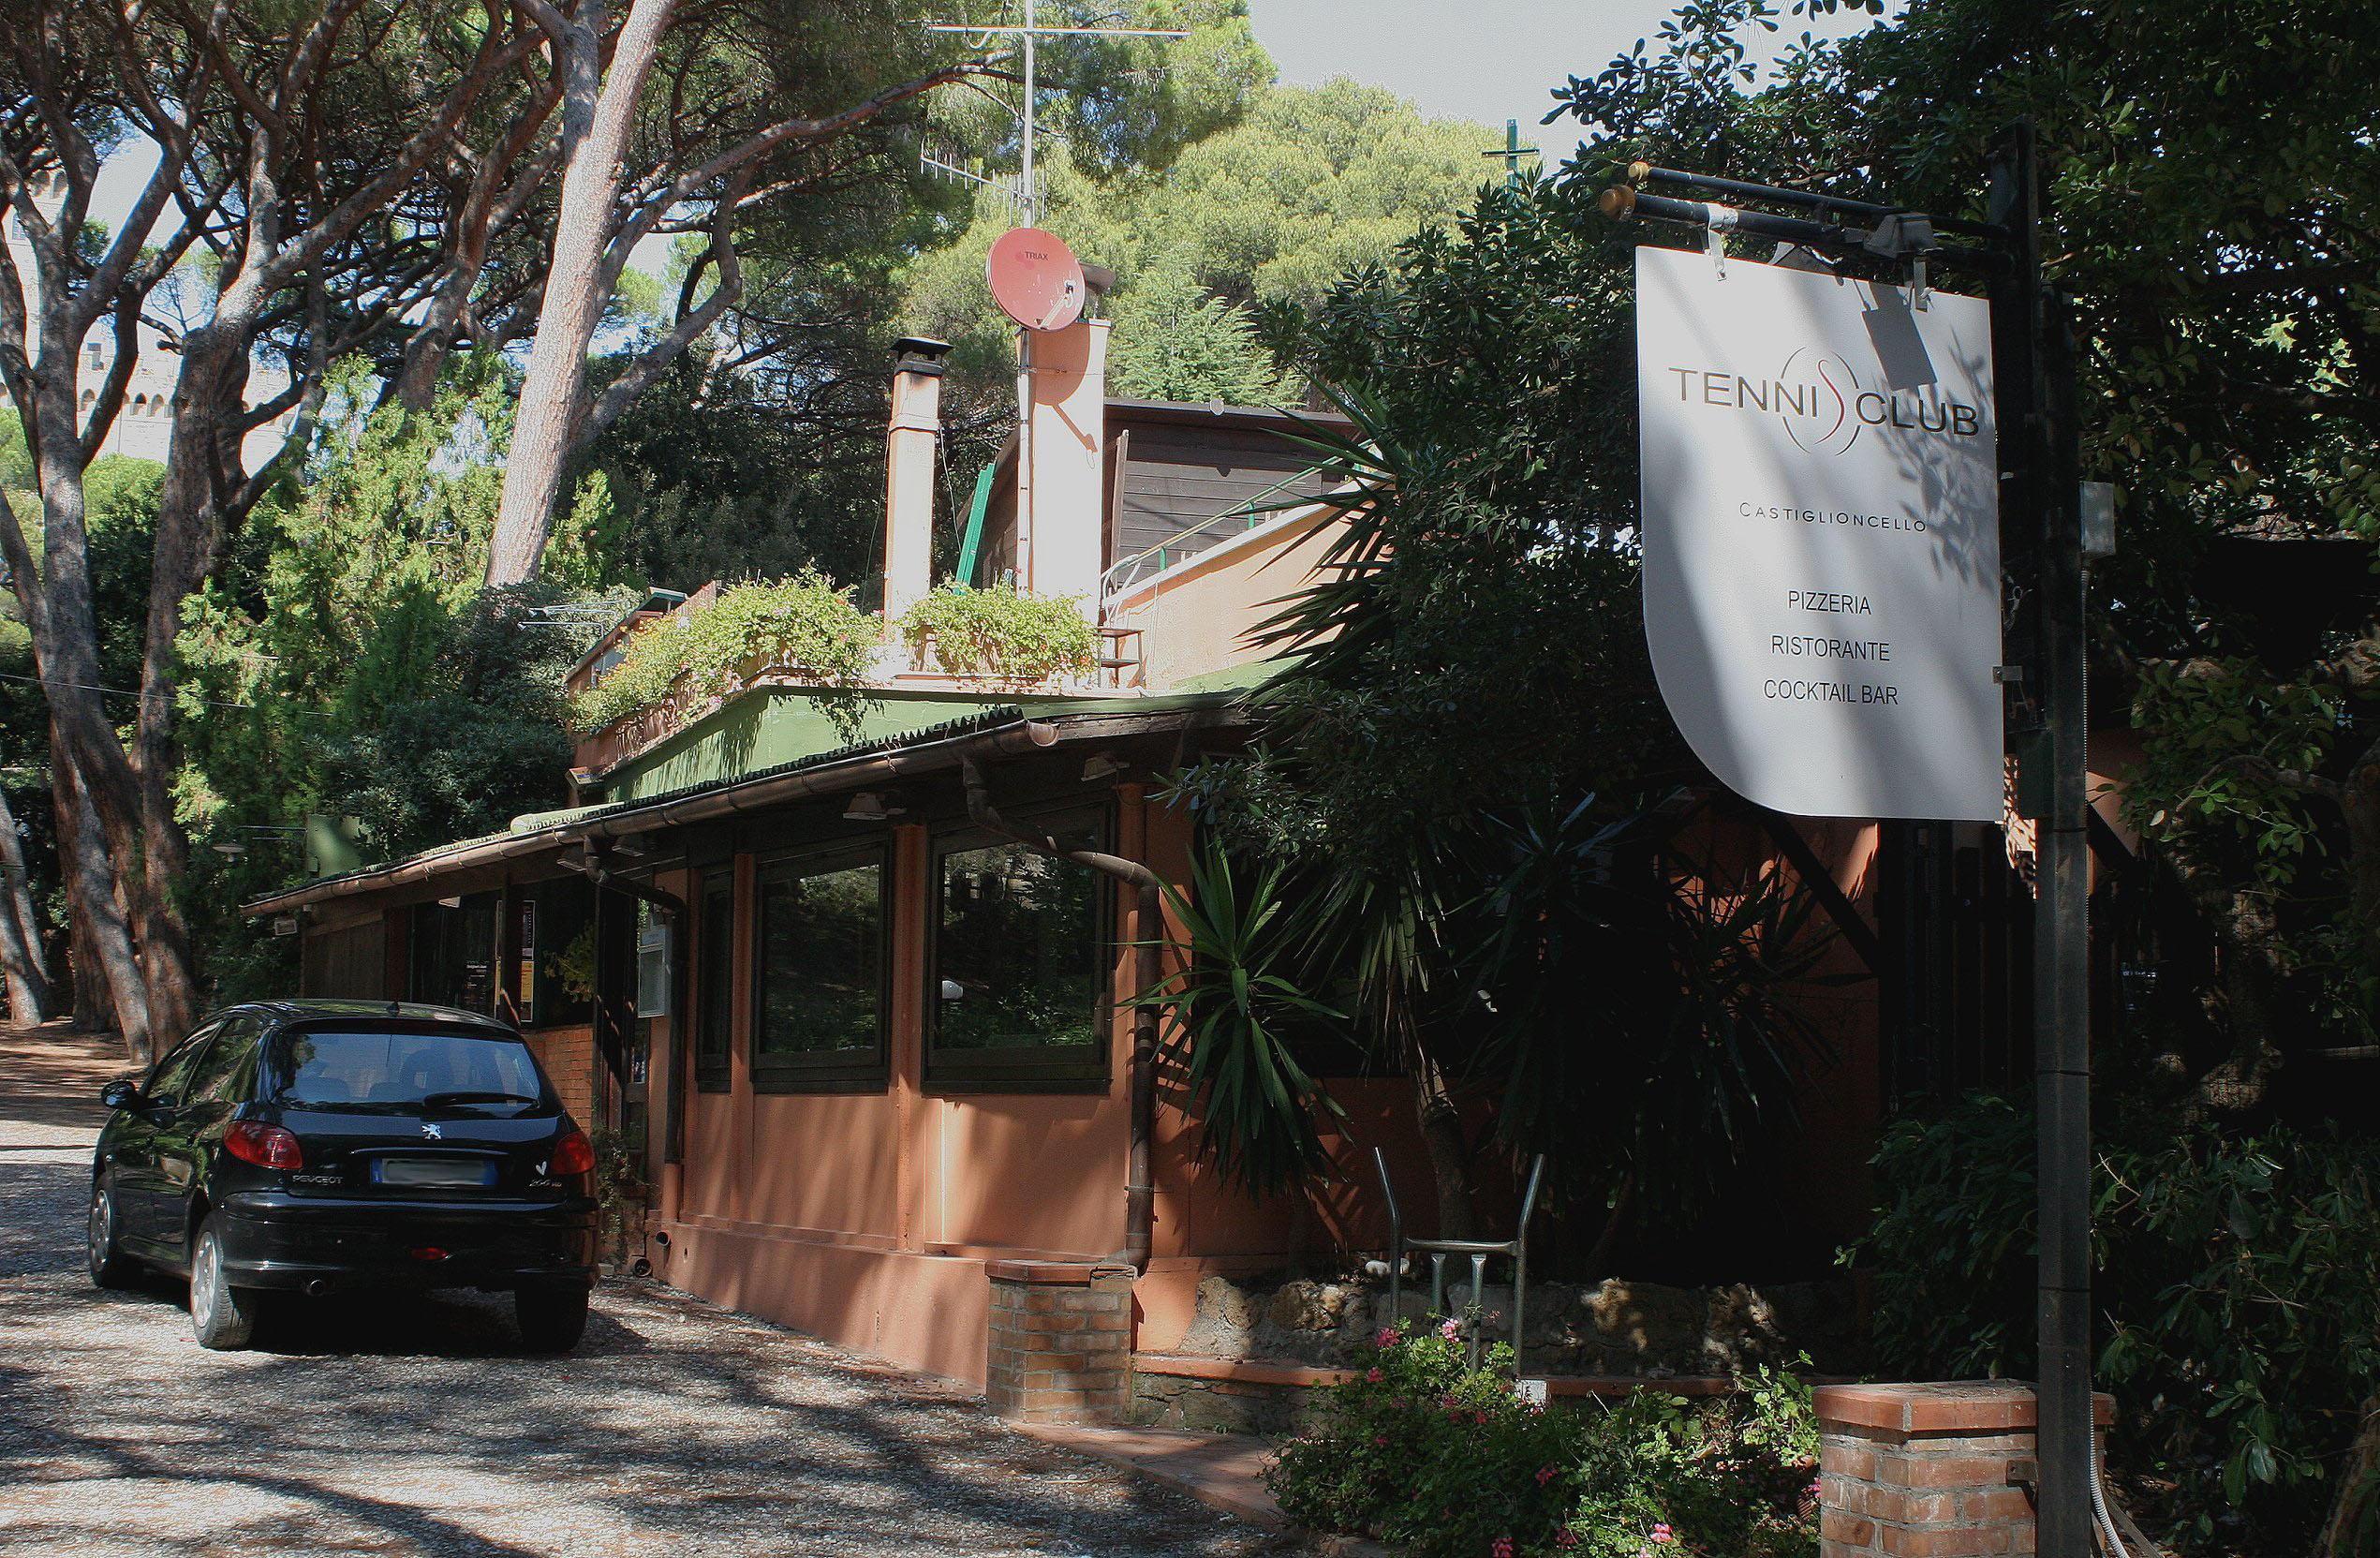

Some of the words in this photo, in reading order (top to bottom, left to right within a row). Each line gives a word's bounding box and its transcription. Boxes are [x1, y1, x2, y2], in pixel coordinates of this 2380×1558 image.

[1025, 251, 1049, 261] TRIAX
[1668, 359, 1845, 445] TENNIS
[1855, 392, 1979, 437] CLUB
[1739, 501, 1926, 532] CASTIGLIONCELLO
[1788, 590, 1872, 616] PIZZERIA
[1771, 635, 1890, 661] RISTORANTE
[1764, 679, 1856, 703] COCKTAIL
[1861, 685, 1899, 705] BAR
[292, 1175, 344, 1185] PEUGEOT
